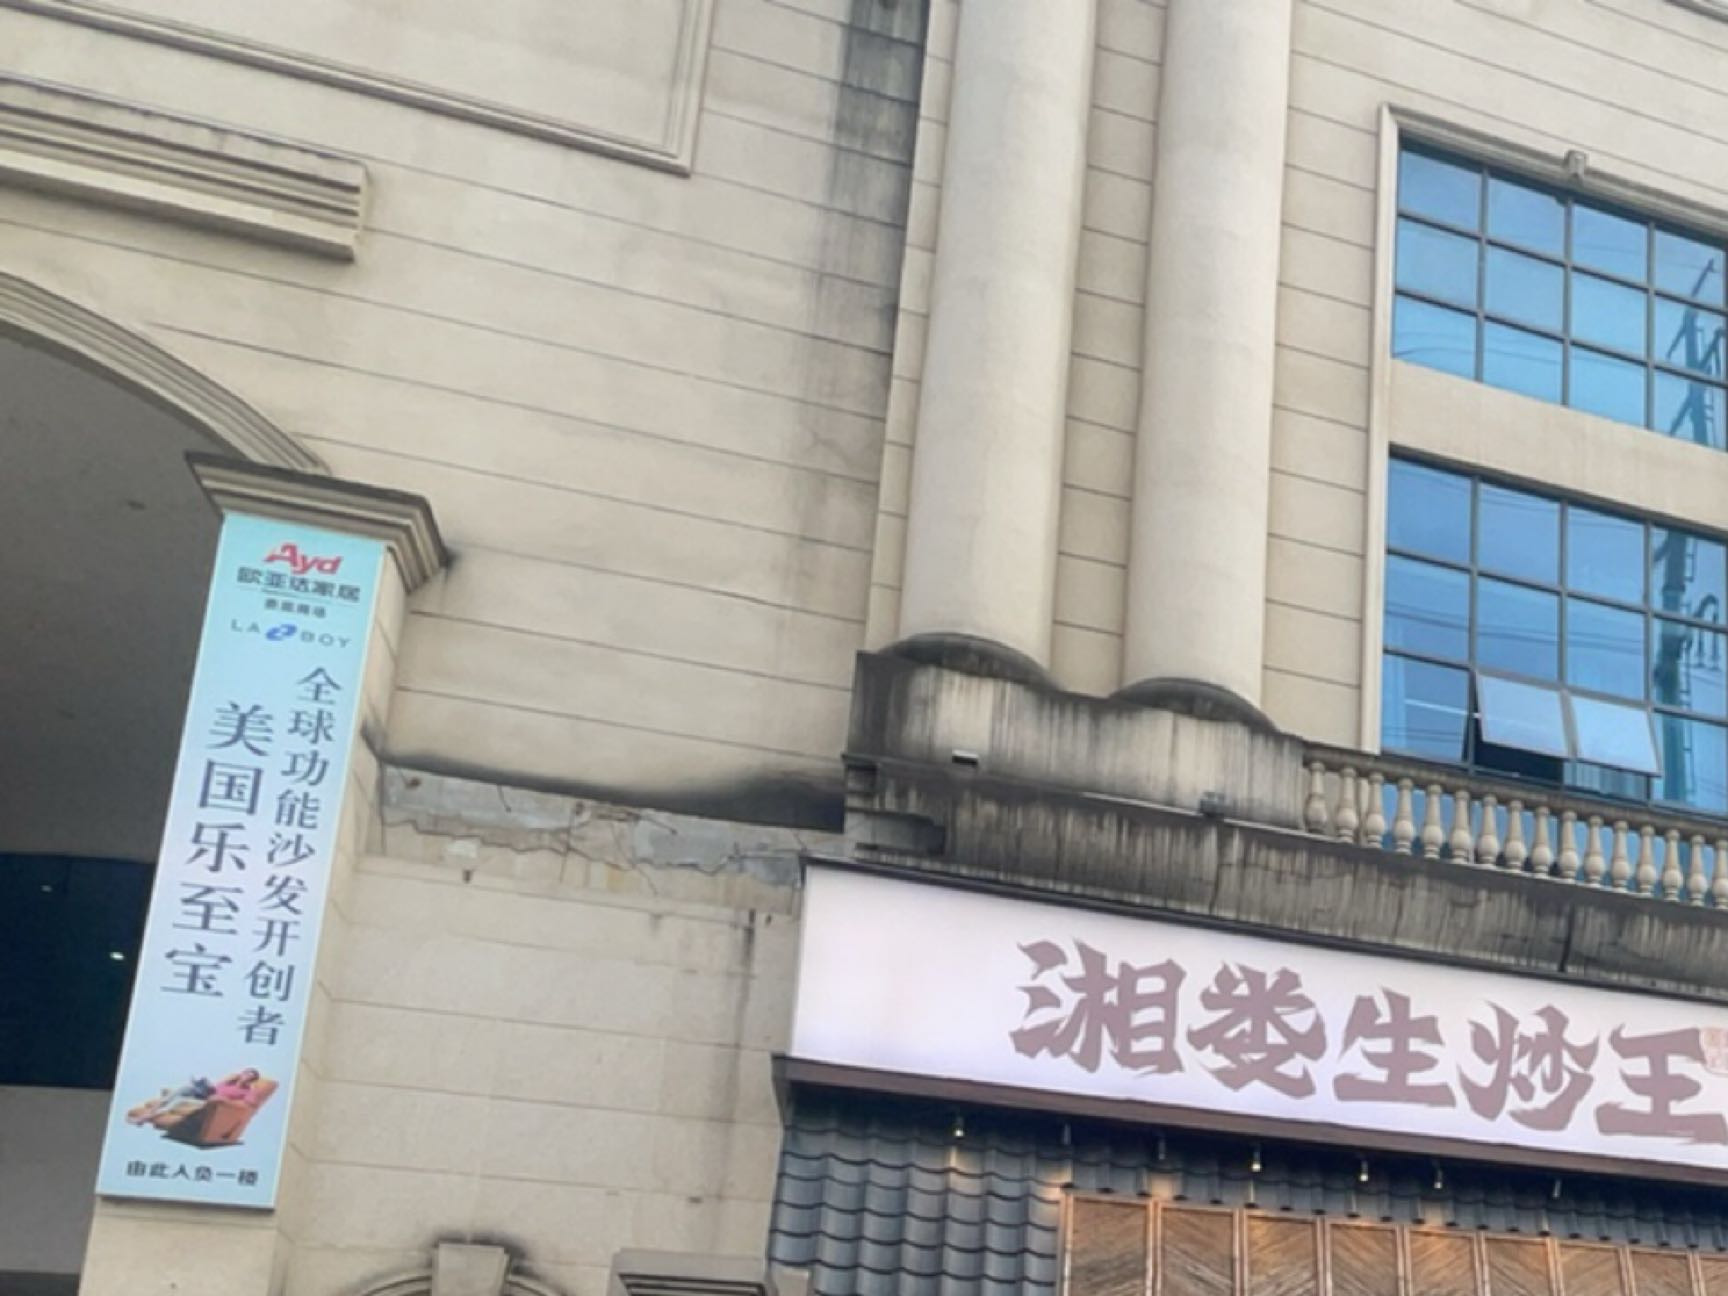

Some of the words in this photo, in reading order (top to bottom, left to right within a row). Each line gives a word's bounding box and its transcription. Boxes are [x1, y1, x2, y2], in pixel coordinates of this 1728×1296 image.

[161, 701, 275, 998] 美国乐至宝
[237, 666, 343, 1047] 全球功能沙发开创者
